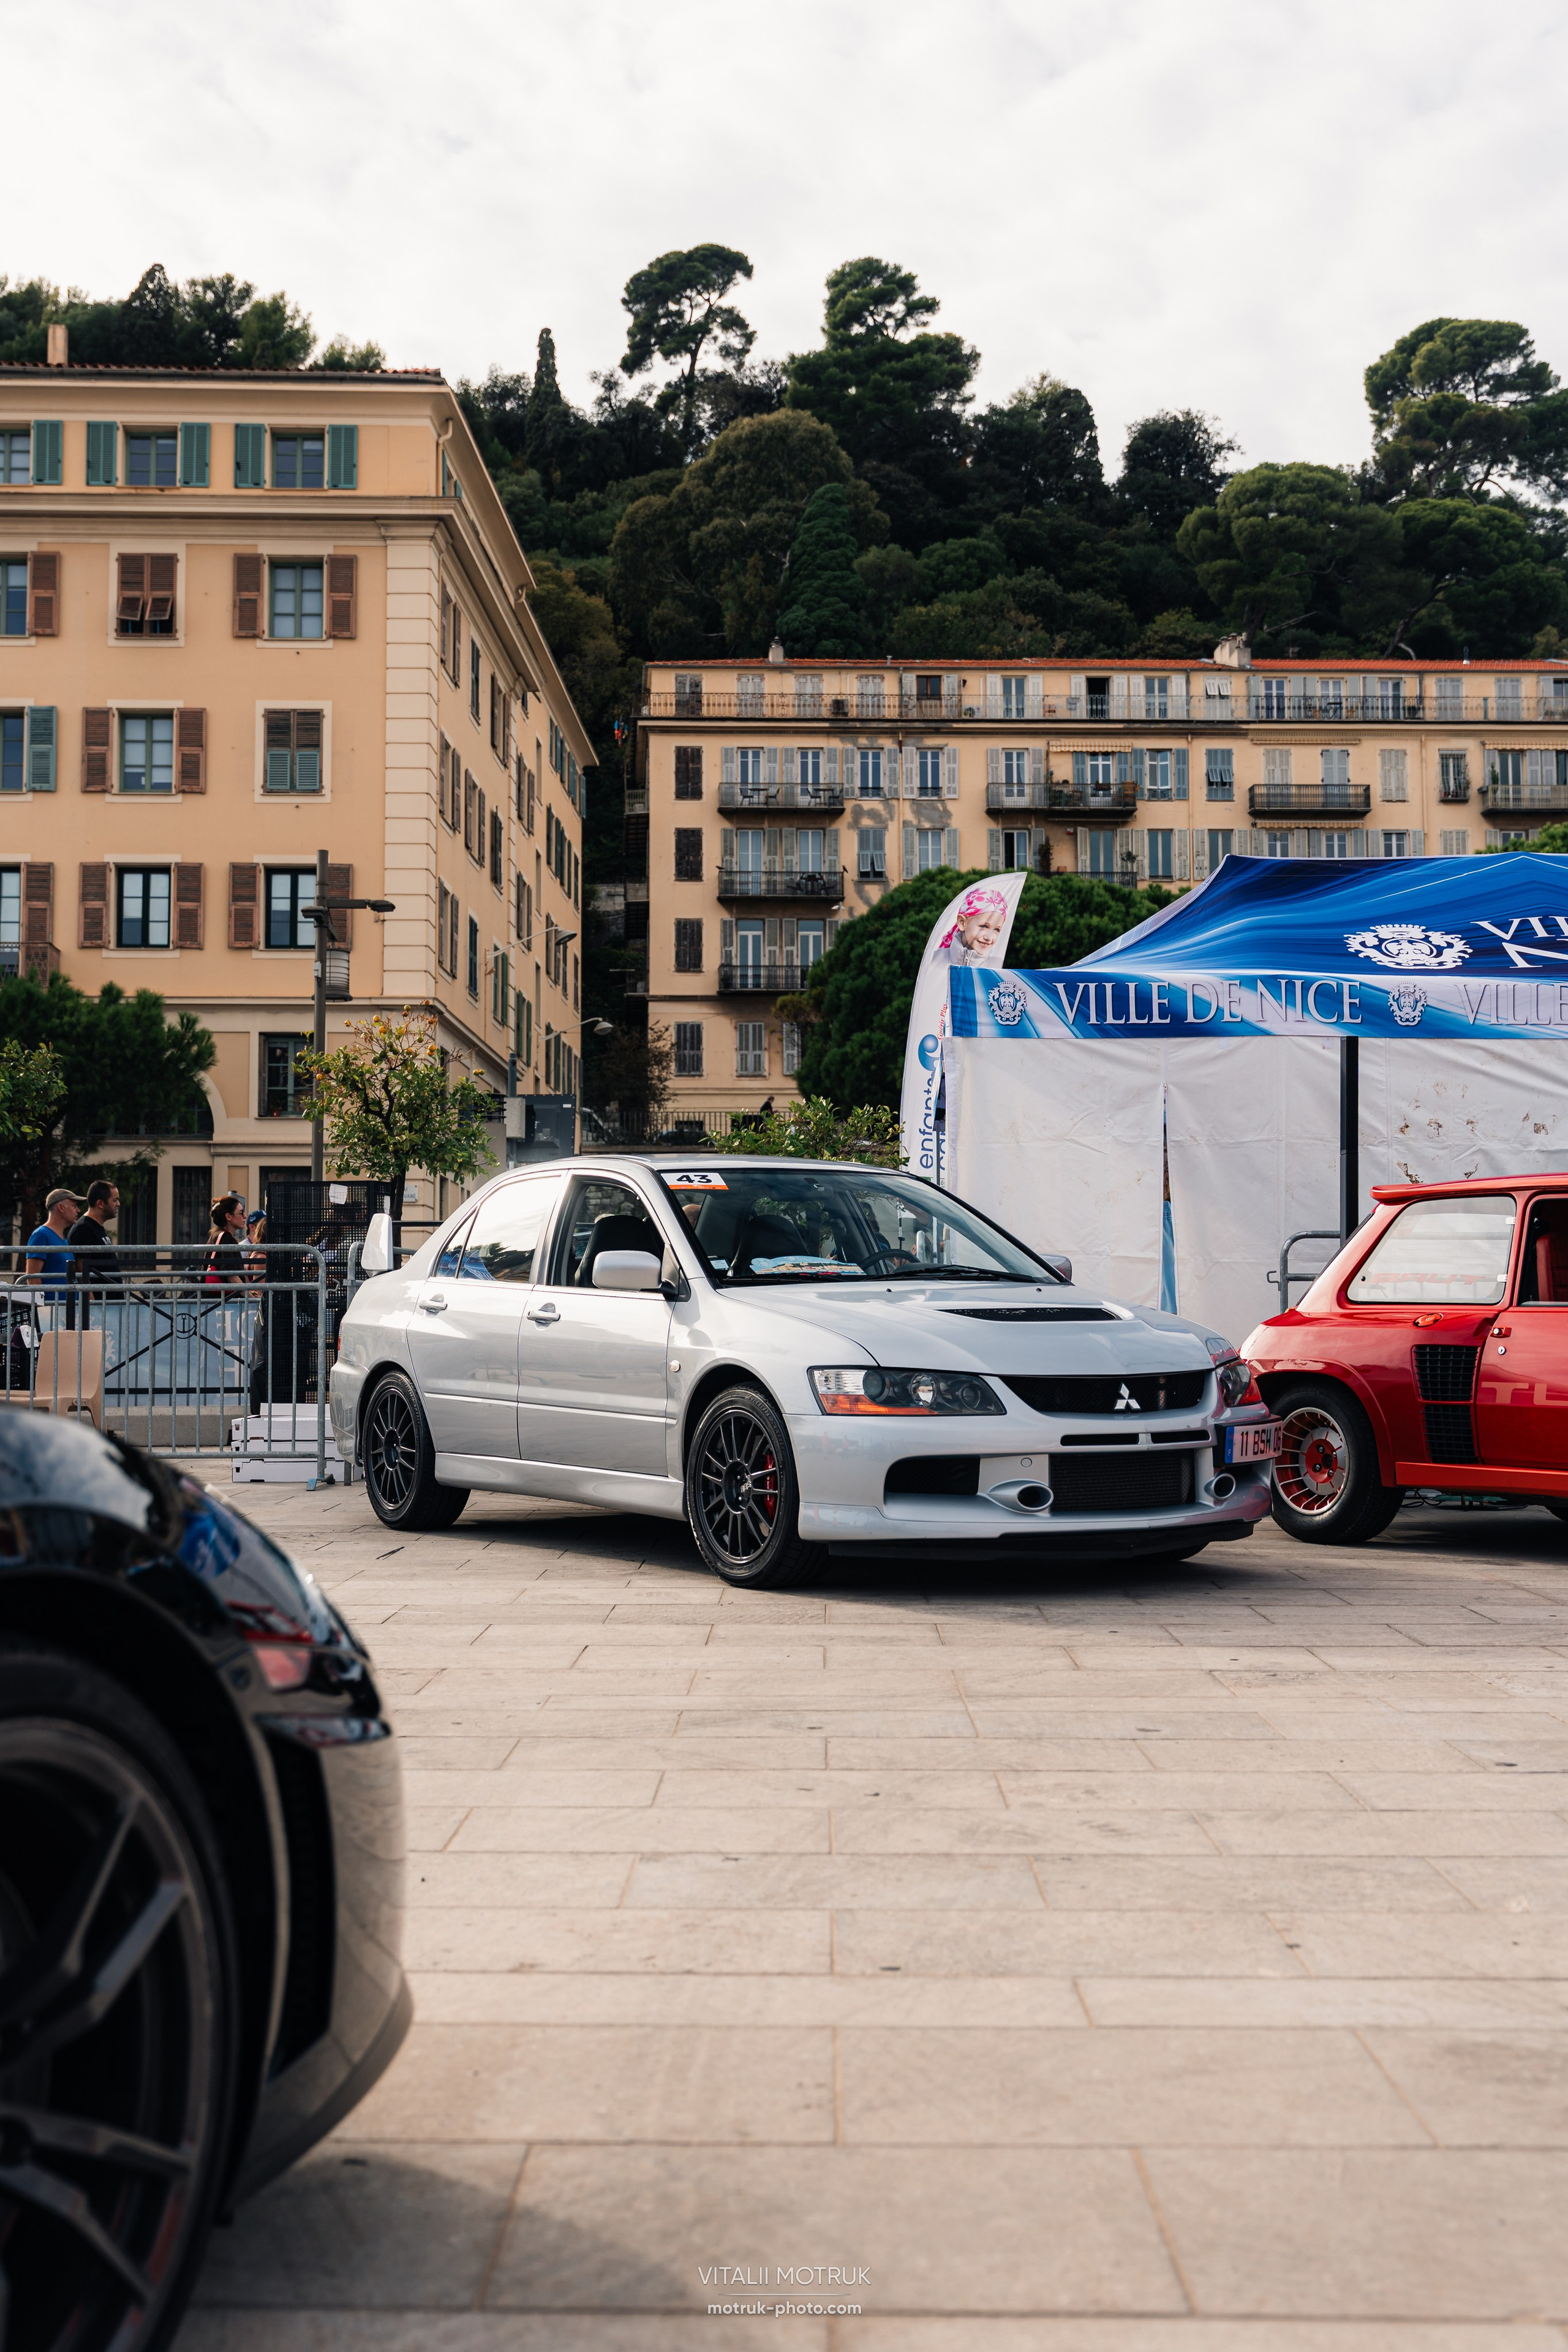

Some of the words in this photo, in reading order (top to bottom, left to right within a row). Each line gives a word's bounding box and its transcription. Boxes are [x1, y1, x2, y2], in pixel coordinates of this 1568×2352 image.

[1052, 981, 1171, 1025] VILLE
[1183, 979, 1243, 1023] DE
[1255, 979, 1362, 1023] NICE
[1455, 982, 1568, 1025] VILLE
[676, 1174, 712, 1183] 43
[1240, 1431, 1249, 1457] 11
[1253, 1428, 1272, 1456] BSH
[1273, 1426, 1281, 1452] 06
